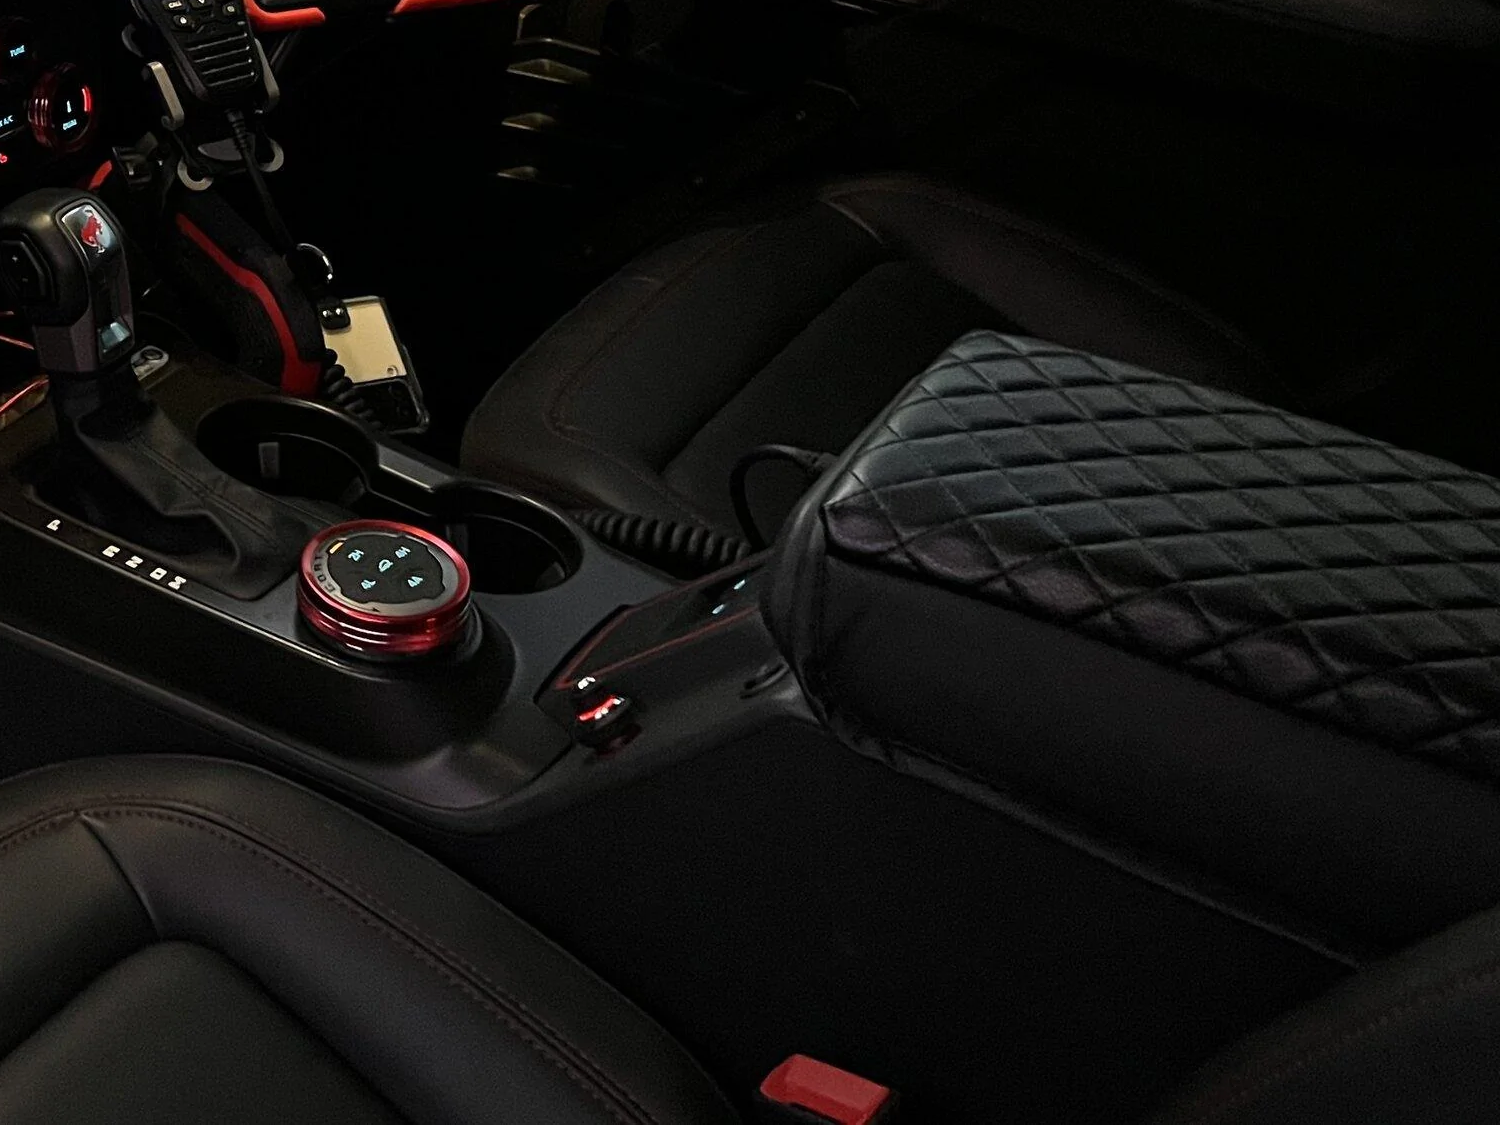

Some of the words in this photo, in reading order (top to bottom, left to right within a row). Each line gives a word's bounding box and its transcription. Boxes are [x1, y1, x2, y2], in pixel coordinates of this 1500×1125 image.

[46, 519, 61, 532] P
[348, 549, 365, 562] 2H
[125, 555, 144, 569] N
[149, 567, 168, 581] D
[168, 576, 187, 590] M
